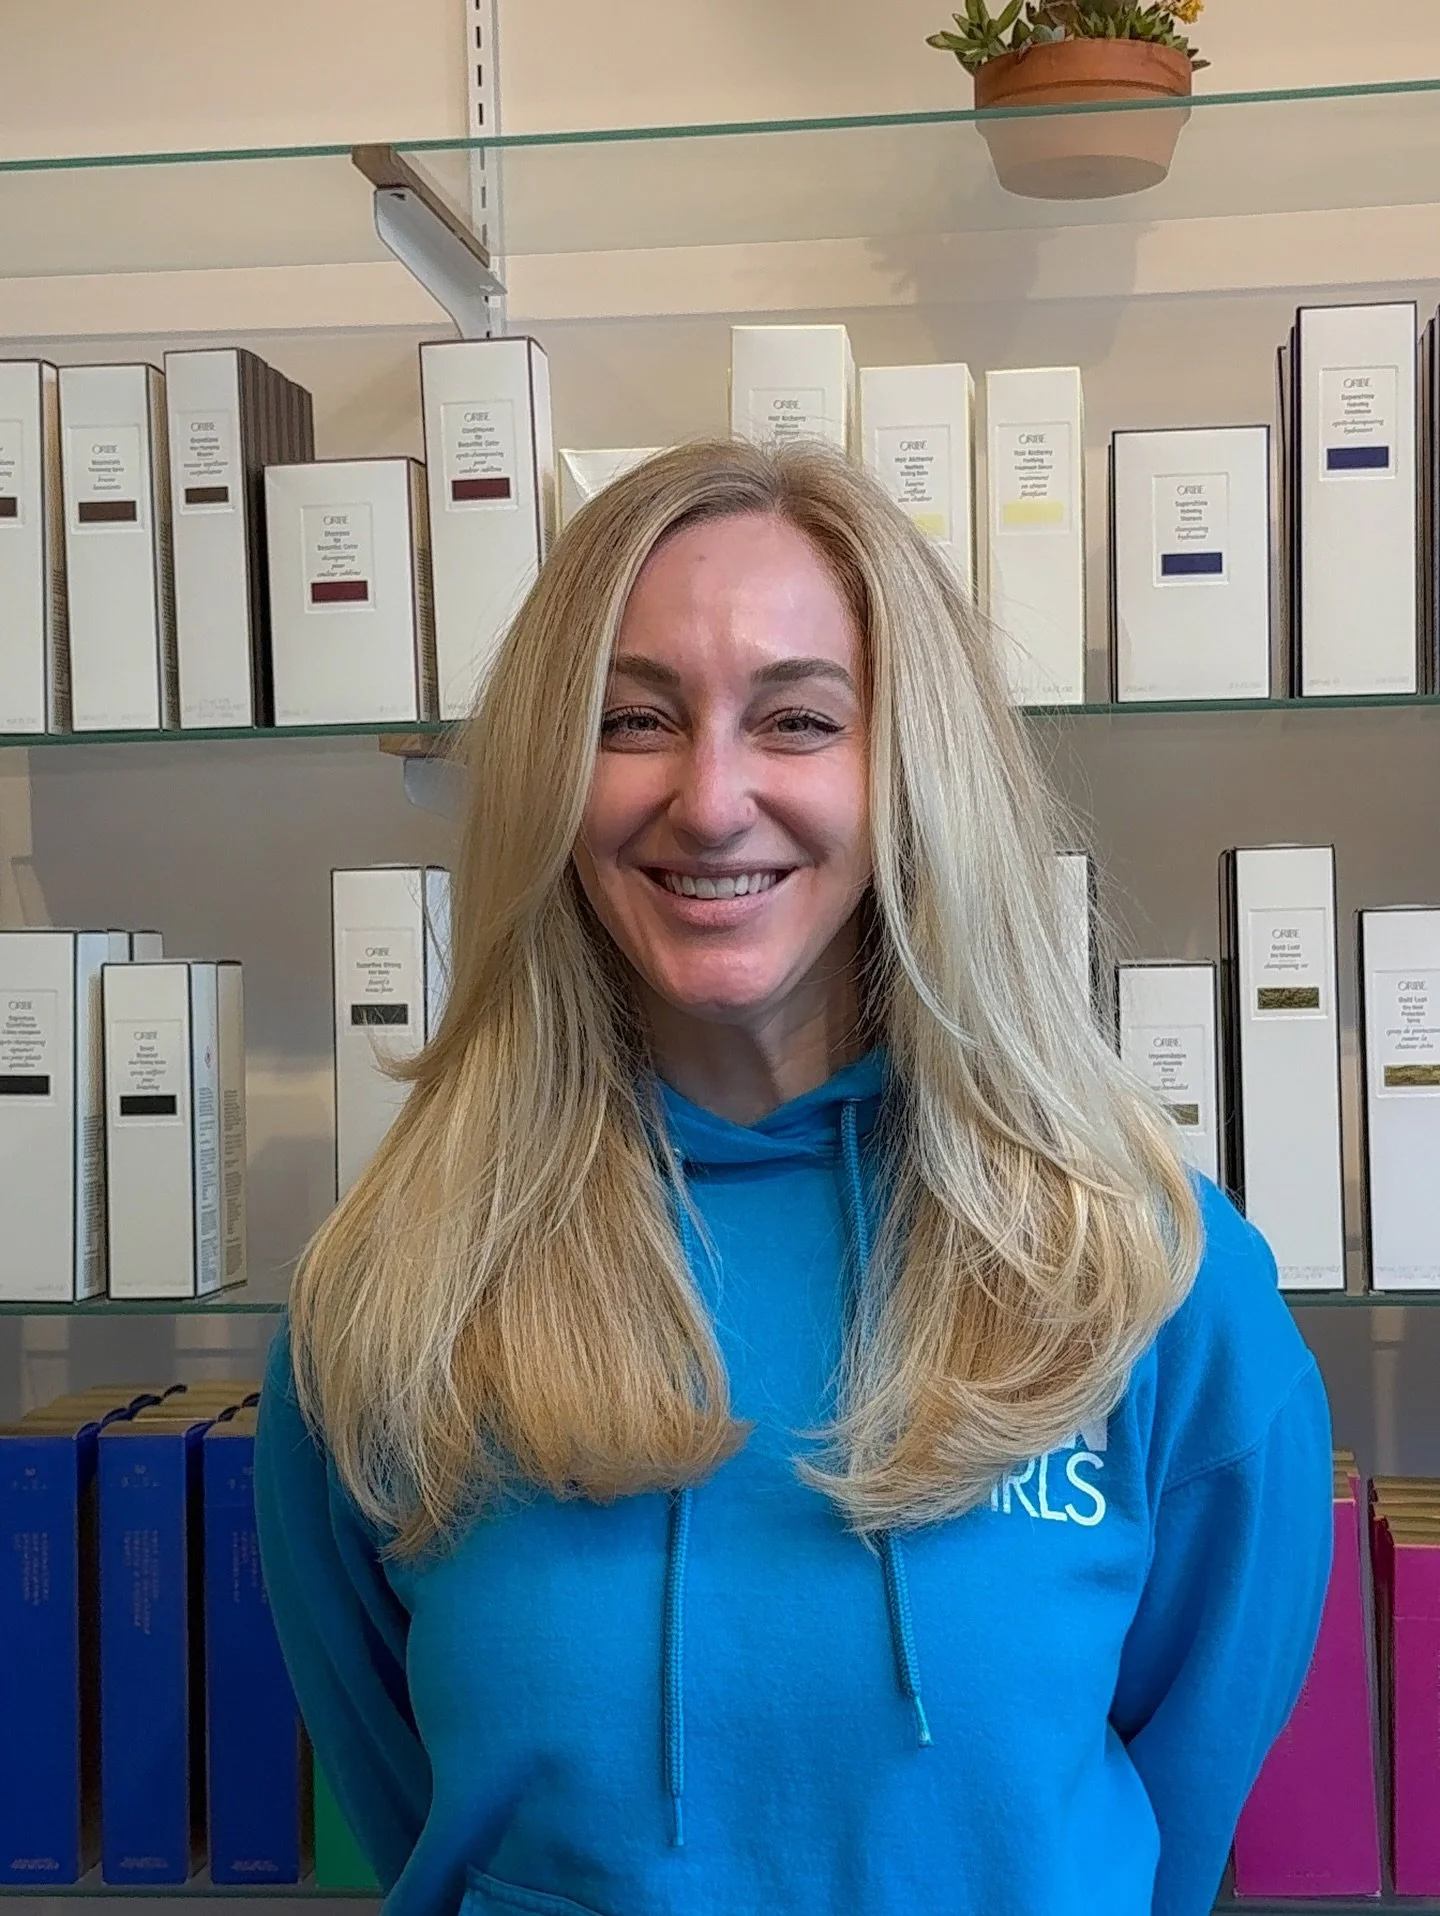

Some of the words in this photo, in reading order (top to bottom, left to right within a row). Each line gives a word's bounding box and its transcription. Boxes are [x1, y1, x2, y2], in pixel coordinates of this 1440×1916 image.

[1343, 378, 1372, 389] ORIBE
[773, 400, 800, 409] ORIBE
[464, 411, 491, 422] ORIBE
[1018, 433, 1046, 444] ORIBE
[900, 440, 927, 451] ORIBE
[1176, 485, 1206, 496] ORIBE
[323, 516, 349, 525] ORIBE
[1272, 929, 1301, 939] ORIBE
[1398, 981, 1428, 991] ORIBE
[1152, 1038, 1181, 1047] ORIBE
